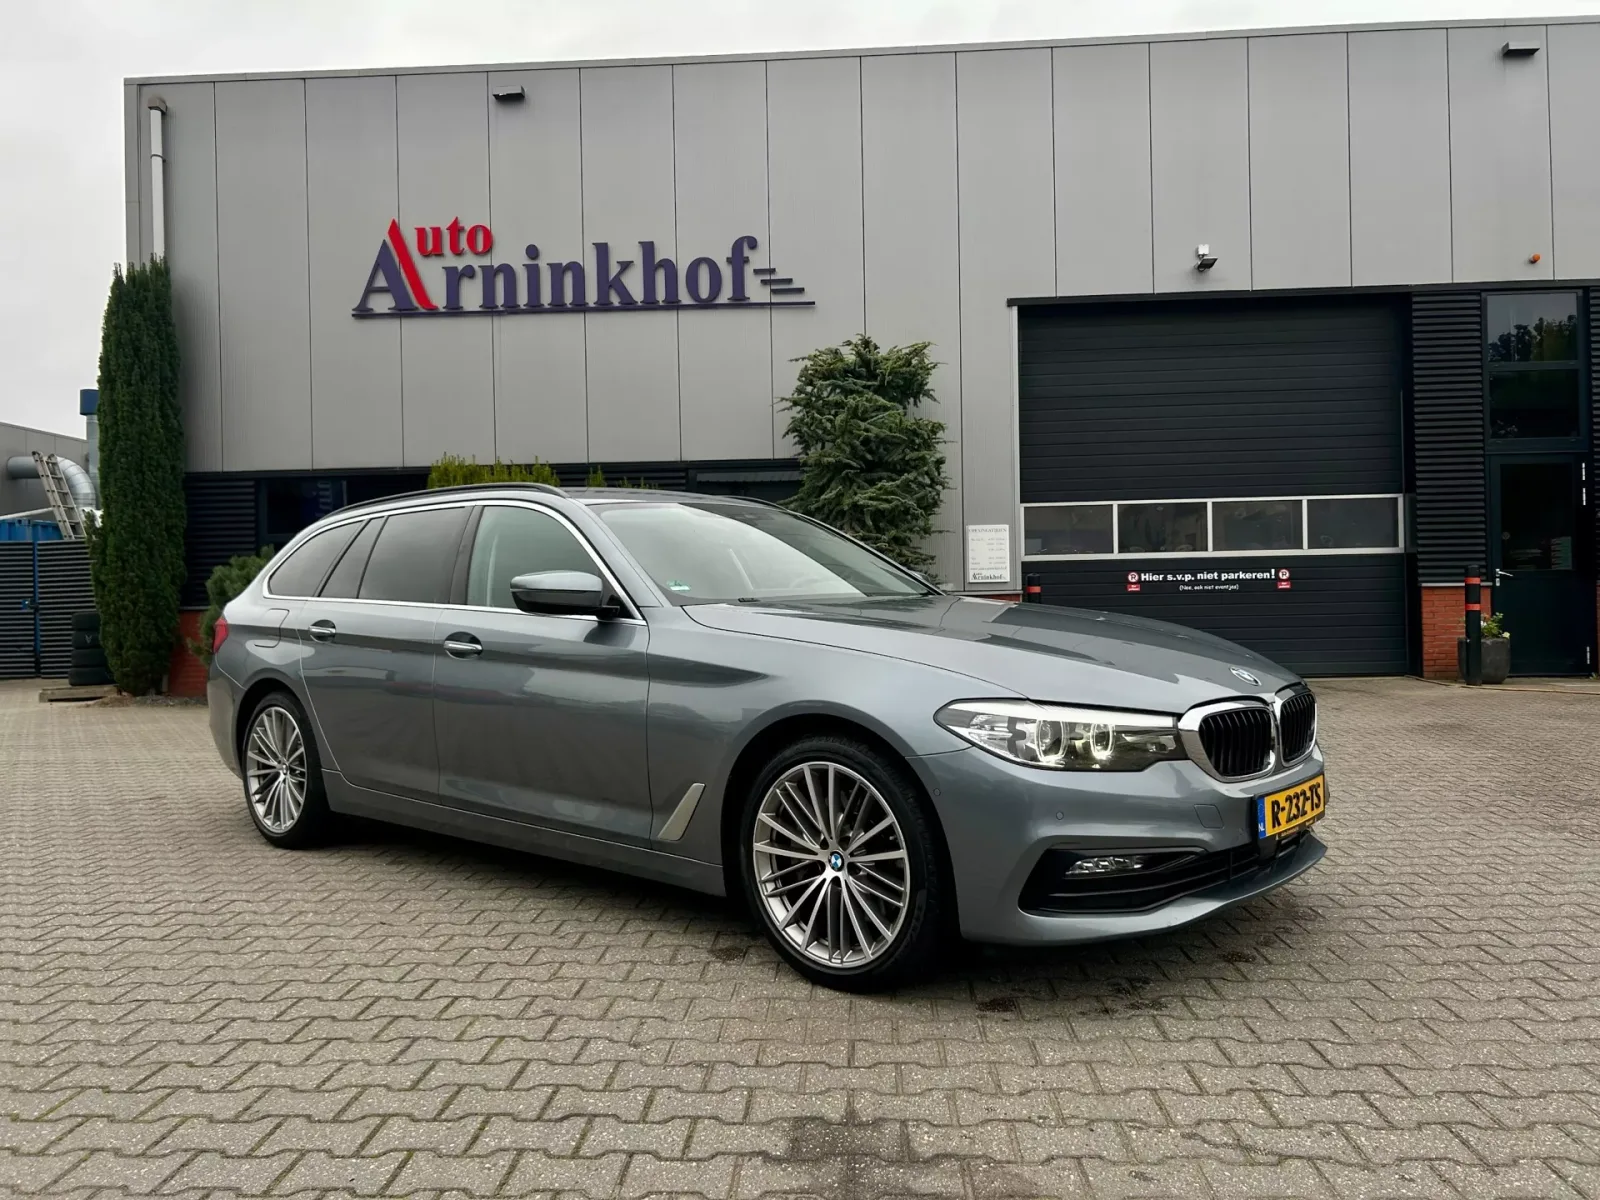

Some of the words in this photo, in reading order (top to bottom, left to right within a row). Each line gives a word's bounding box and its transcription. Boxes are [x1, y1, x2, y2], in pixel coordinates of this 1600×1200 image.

[352, 235, 758, 312] Arninkhof
[1141, 572, 1164, 581] Hier
[1167, 574, 1195, 582] s.v.p.
[1197, 571, 1219, 580] niet
[1221, 568, 1276, 581] parkeren!
[1271, 782, 1321, 829] R-232-TS
